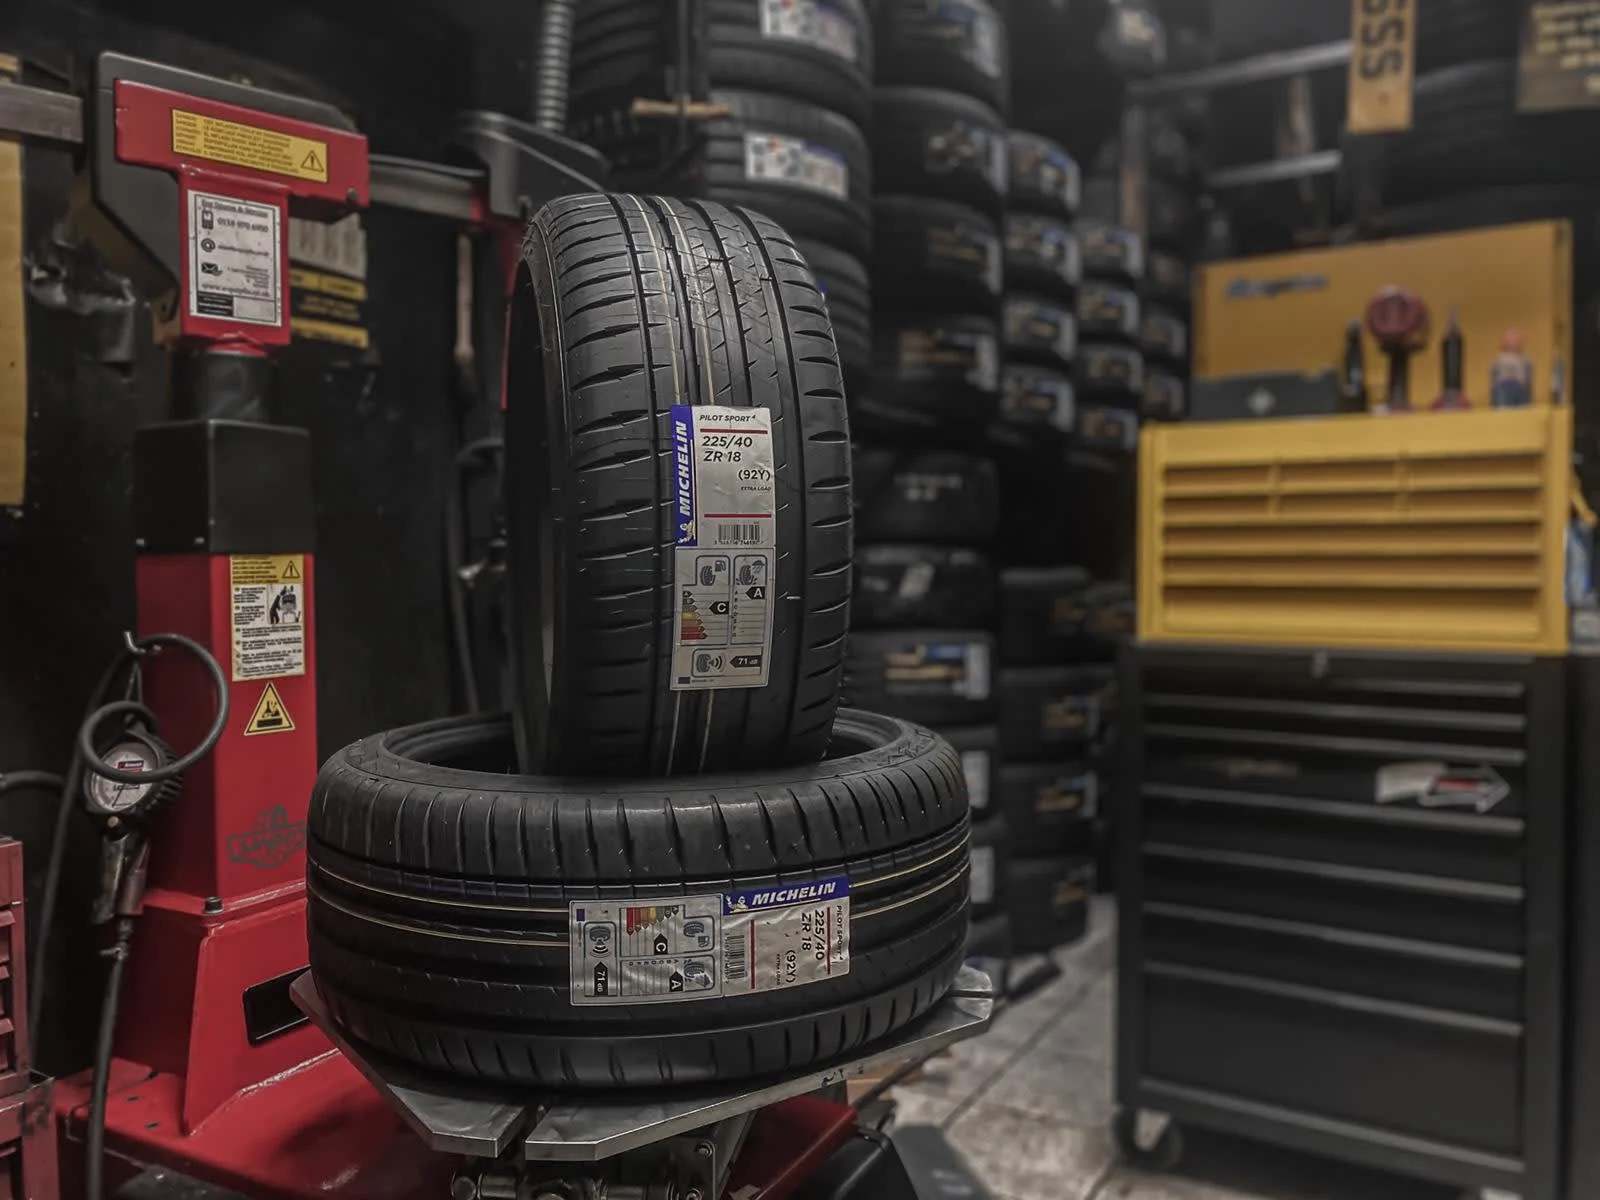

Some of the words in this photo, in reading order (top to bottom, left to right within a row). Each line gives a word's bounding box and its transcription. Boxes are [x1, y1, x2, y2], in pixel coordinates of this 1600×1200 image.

[702, 435, 753, 449] 225/40
[703, 450, 723, 462] ZR
[727, 451, 742, 462] 18
[675, 420, 691, 517] MICHELIN
[738, 469, 771, 481] (92Y)
[753, 587, 763, 598] A
[717, 602, 727, 613] C
[738, 657, 748, 665] 71
[752, 882, 837, 906] MICHELIN
[801, 912, 812, 932] ZR
[814, 909, 825, 961] 225/40
[655, 942, 667, 953] C
[801, 936, 812, 951] 18
[785, 949, 797, 983] (92Y)
[597, 970, 606, 981] 71
[671, 979, 682, 990] A
